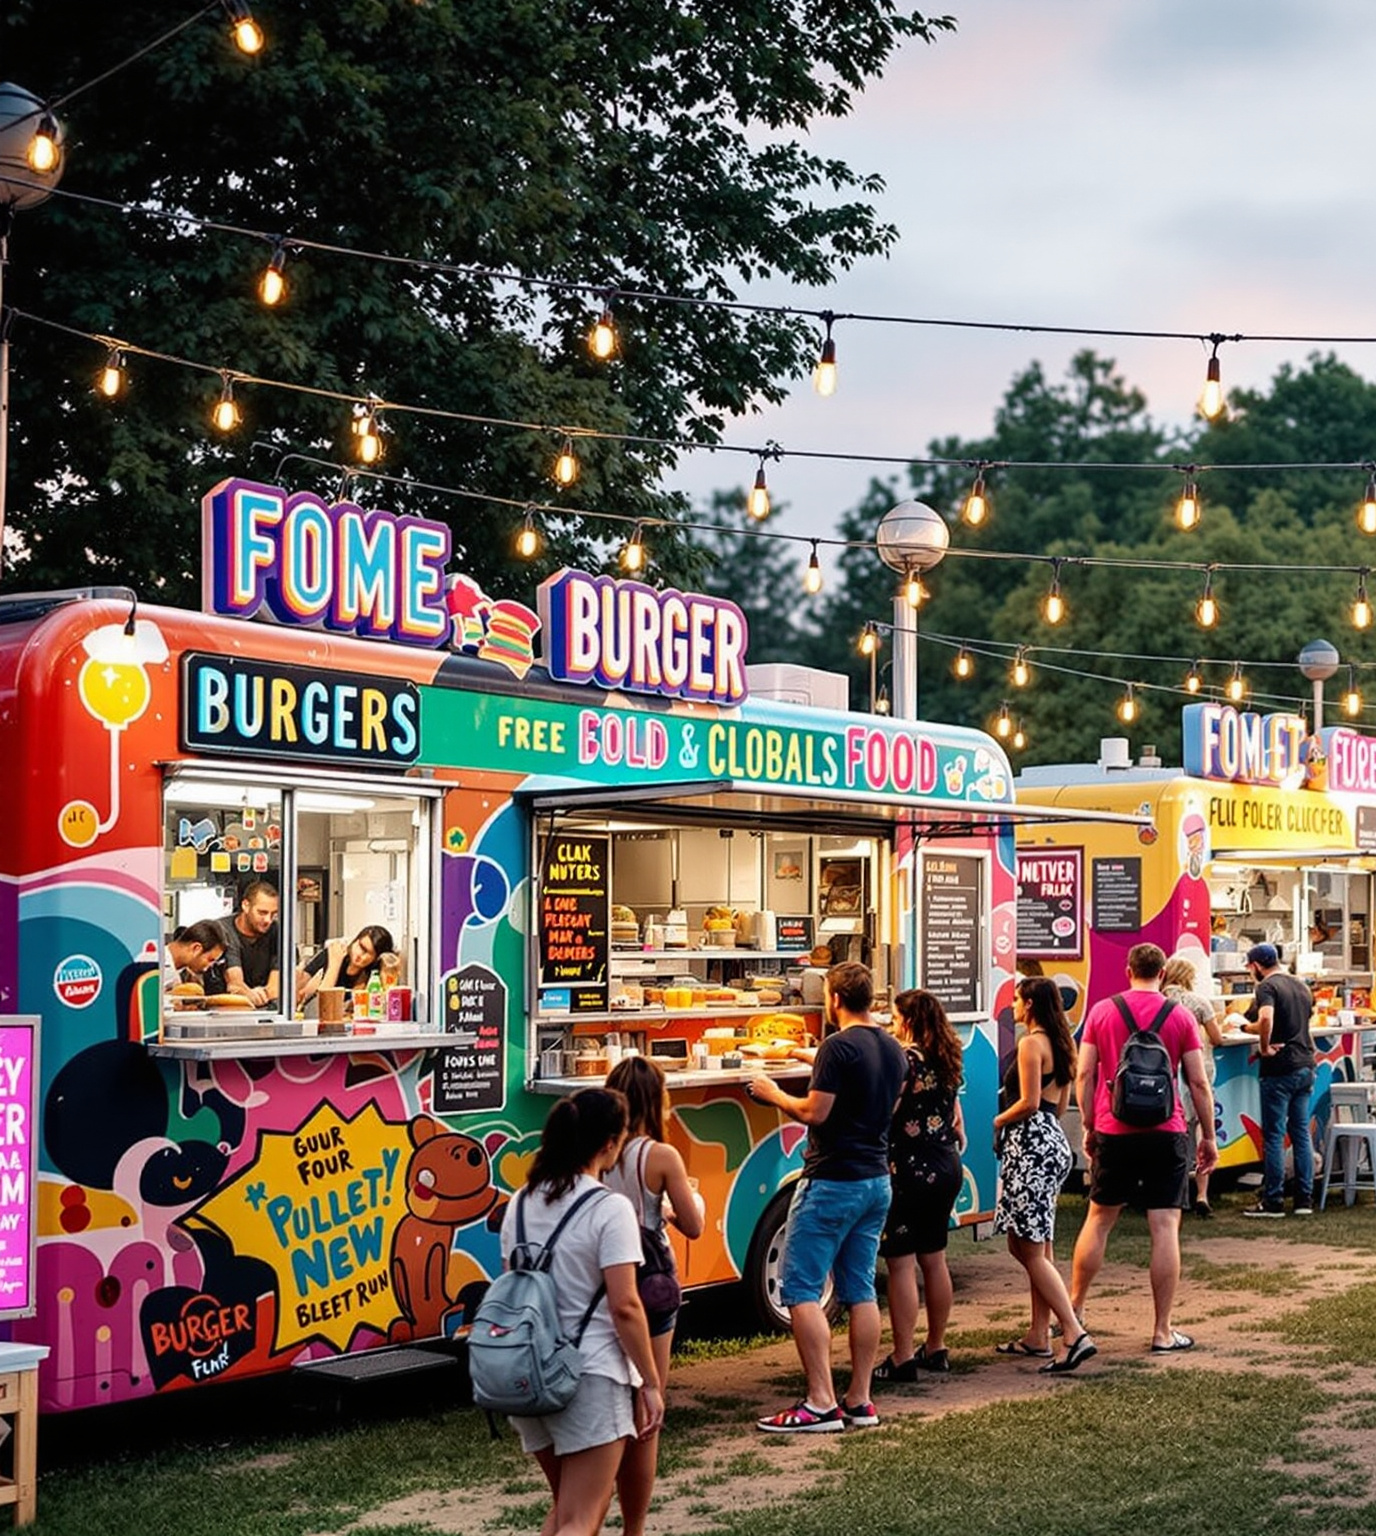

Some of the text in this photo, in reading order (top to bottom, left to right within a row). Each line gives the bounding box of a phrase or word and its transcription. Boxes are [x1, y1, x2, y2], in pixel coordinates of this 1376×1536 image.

[229, 489, 450, 642] FOME
[566, 576, 745, 699] BURGER
[198, 666, 417, 755] BURGERS
[498, 716, 566, 753] FREE
[578, 709, 669, 771] BOLD
[678, 723, 701, 769] &
[845, 725, 938, 794] FOOD
[293, 1126, 345, 1158] GUUR
[297, 1149, 354, 1186] FOUR
[291, 1215, 385, 1297] NEW
[356, 1269, 388, 1308] RUN
[151, 1304, 252, 1356] BURGER
